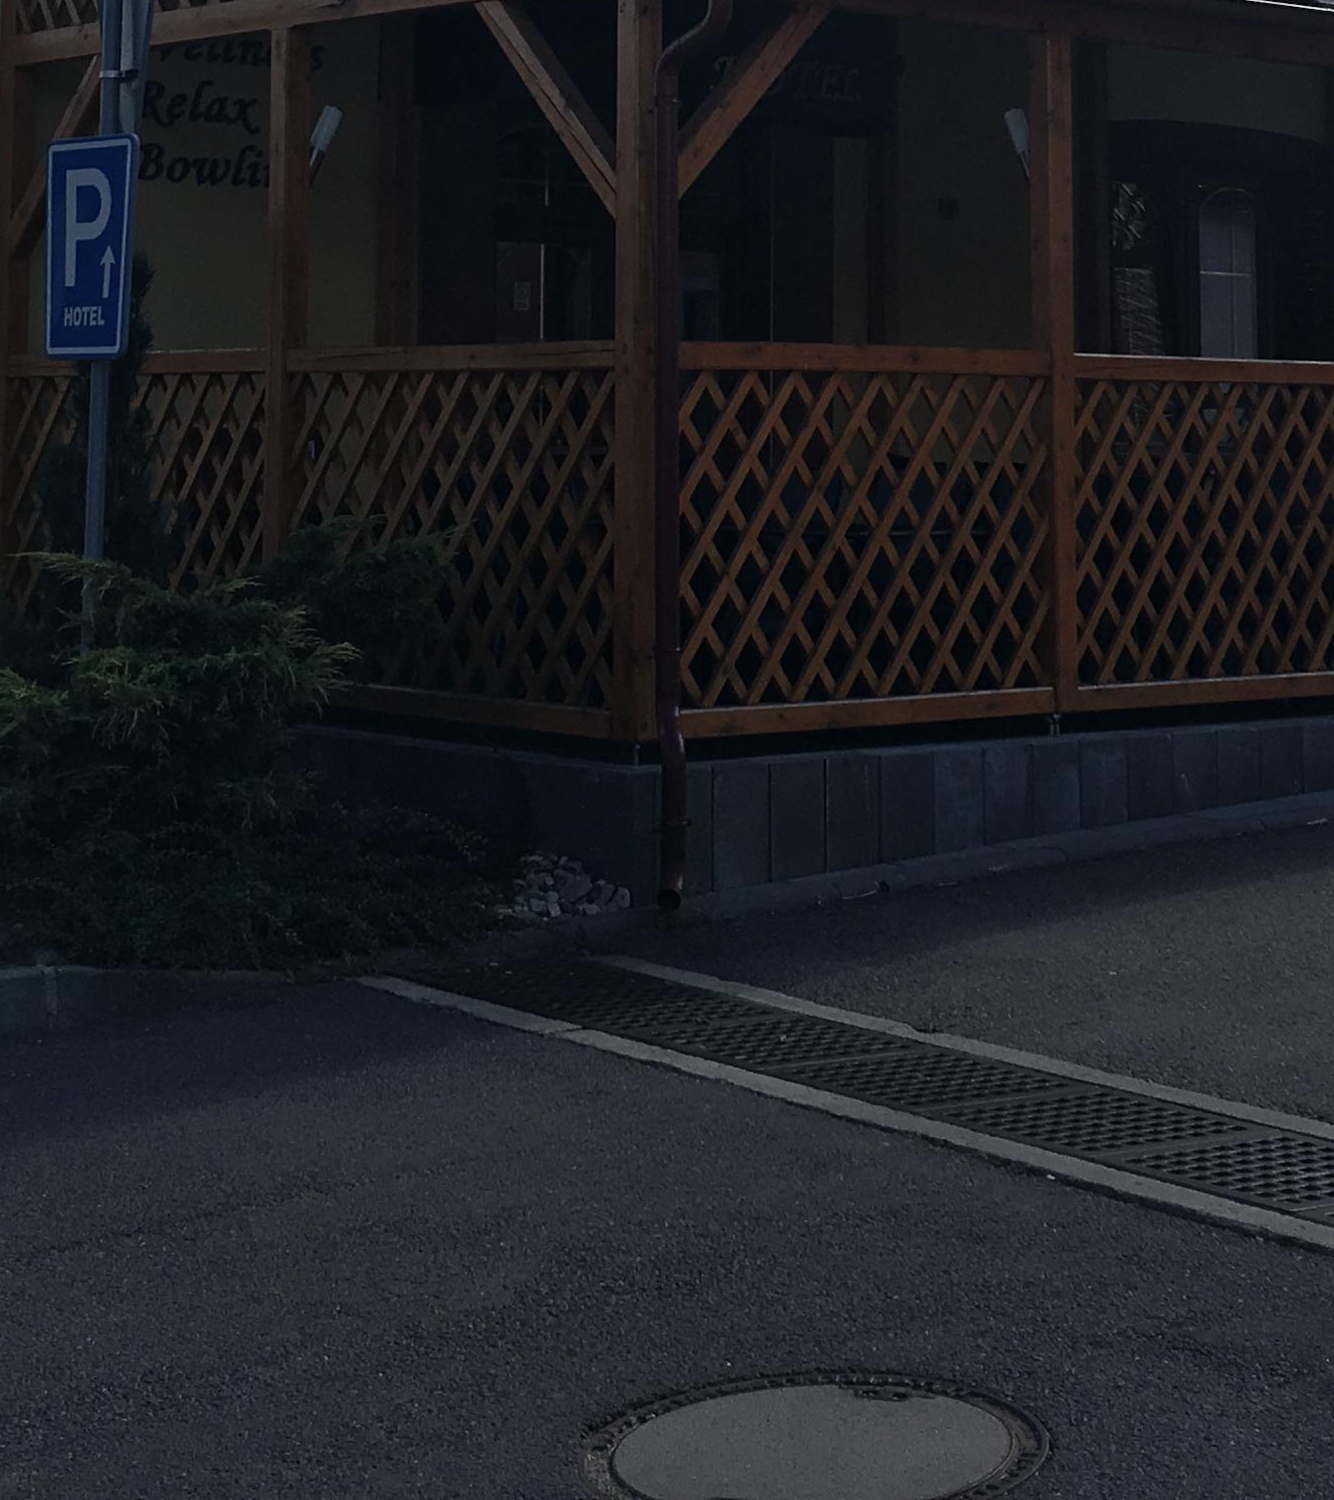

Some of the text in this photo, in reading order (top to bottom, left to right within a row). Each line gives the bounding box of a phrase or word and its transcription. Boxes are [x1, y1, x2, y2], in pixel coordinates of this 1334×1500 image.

[141, 79, 261, 135] Relax
[137, 142, 271, 189] Bowli
[63, 166, 113, 289] P
[63, 305, 106, 327] HOTEL
